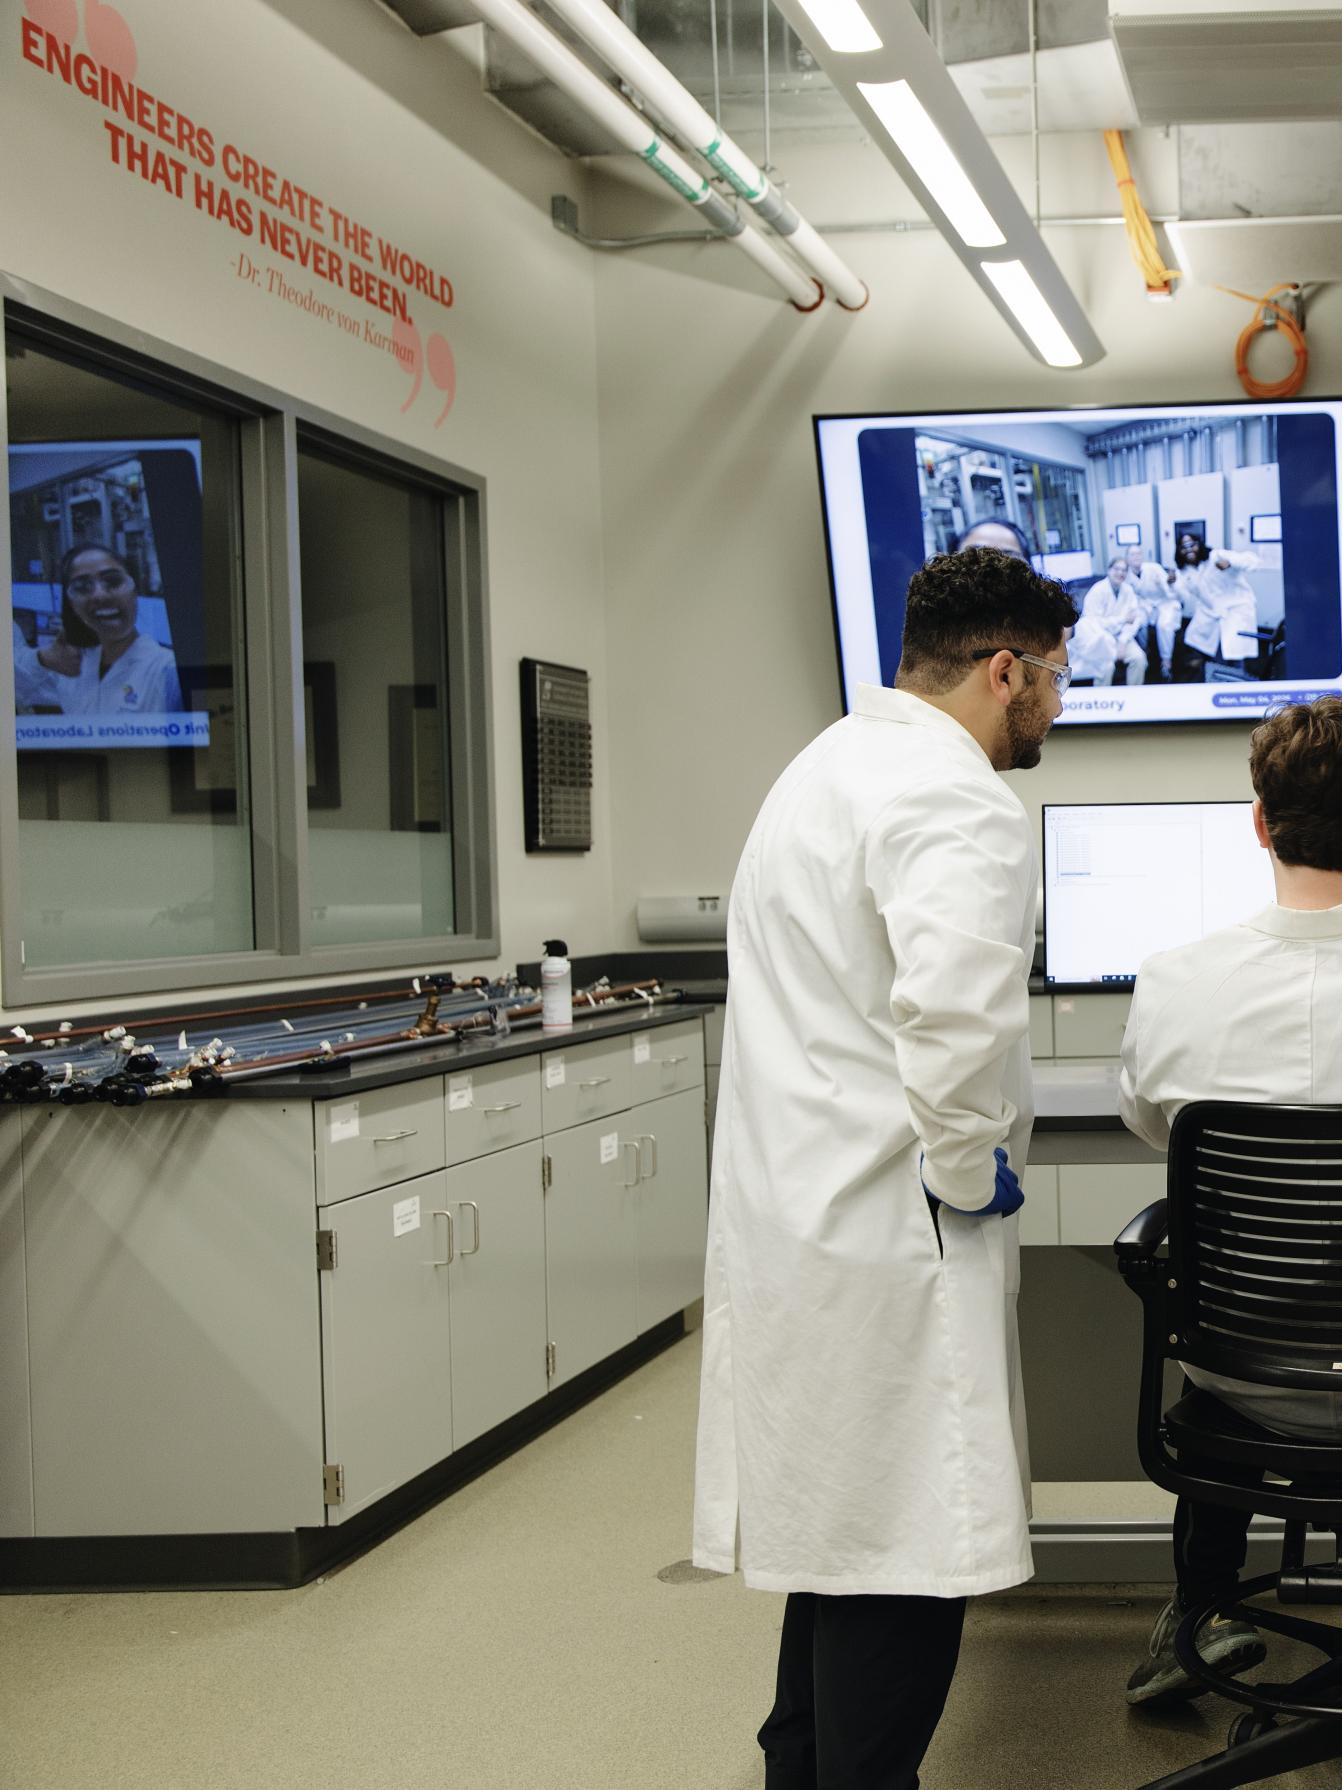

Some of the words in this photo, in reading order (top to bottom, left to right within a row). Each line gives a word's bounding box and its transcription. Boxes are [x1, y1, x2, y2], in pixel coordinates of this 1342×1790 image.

[21, 16, 216, 168] ENGINEERS
[221, 143, 325, 234] CREATE
[328, 206, 375, 263] THE
[378, 237, 455, 309] WORLD
[104, 119, 188, 199] THAT
[194, 172, 254, 237] HAS
[259, 212, 344, 289] NEVER
[348, 261, 414, 326] BEEN.
[265, 266, 336, 325] Theodore
[336, 308, 361, 338] von
[363, 319, 415, 365] Karman
